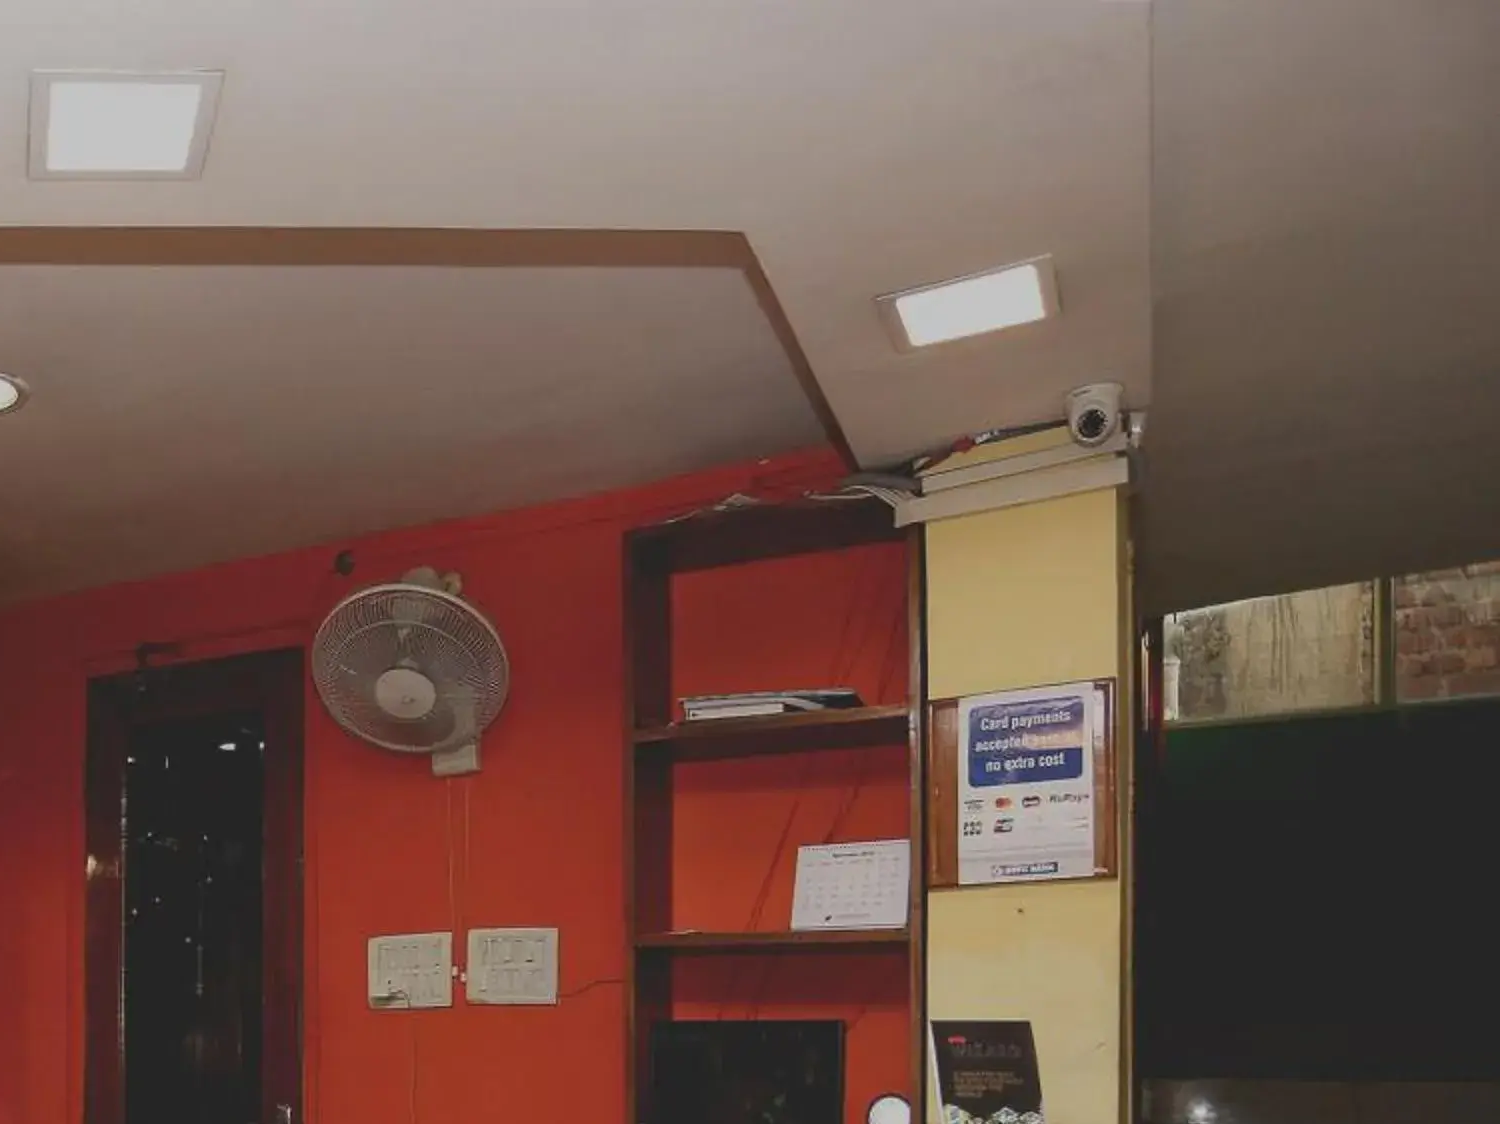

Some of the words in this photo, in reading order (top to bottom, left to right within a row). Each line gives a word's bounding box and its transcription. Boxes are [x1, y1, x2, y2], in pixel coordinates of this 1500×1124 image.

[980, 715, 1009, 731] Card
[1011, 710, 1071, 730] payments
[975, 732, 1028, 752] accepted
[985, 761, 1001, 773] no
[1003, 756, 1035, 771] extra
[1038, 751, 1066, 767] cost
